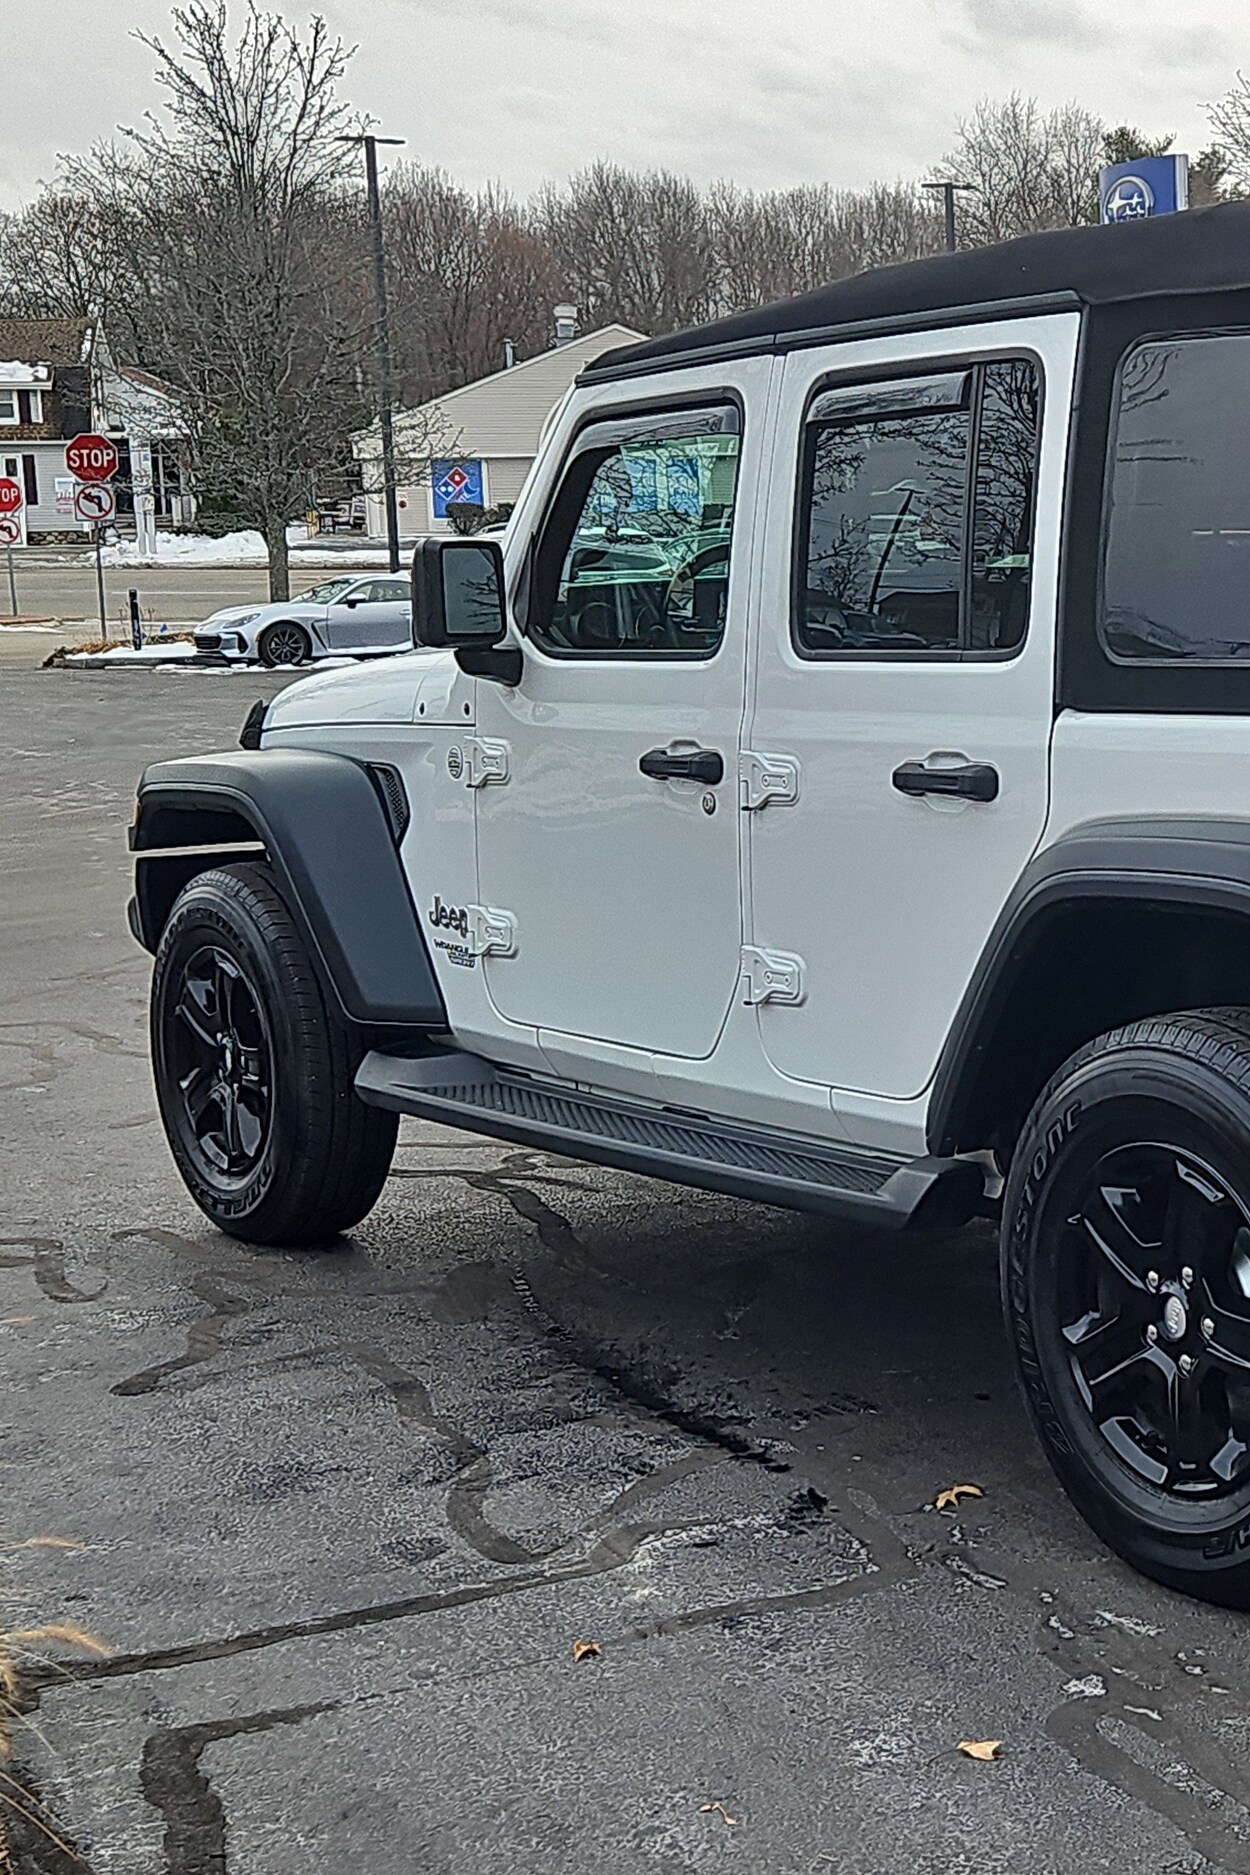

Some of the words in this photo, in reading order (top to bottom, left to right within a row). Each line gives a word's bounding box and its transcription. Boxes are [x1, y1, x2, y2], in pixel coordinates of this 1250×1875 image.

[69, 448, 114, 468] STOP
[0, 487, 19, 503] OP
[428, 895, 468, 939] Jeep
